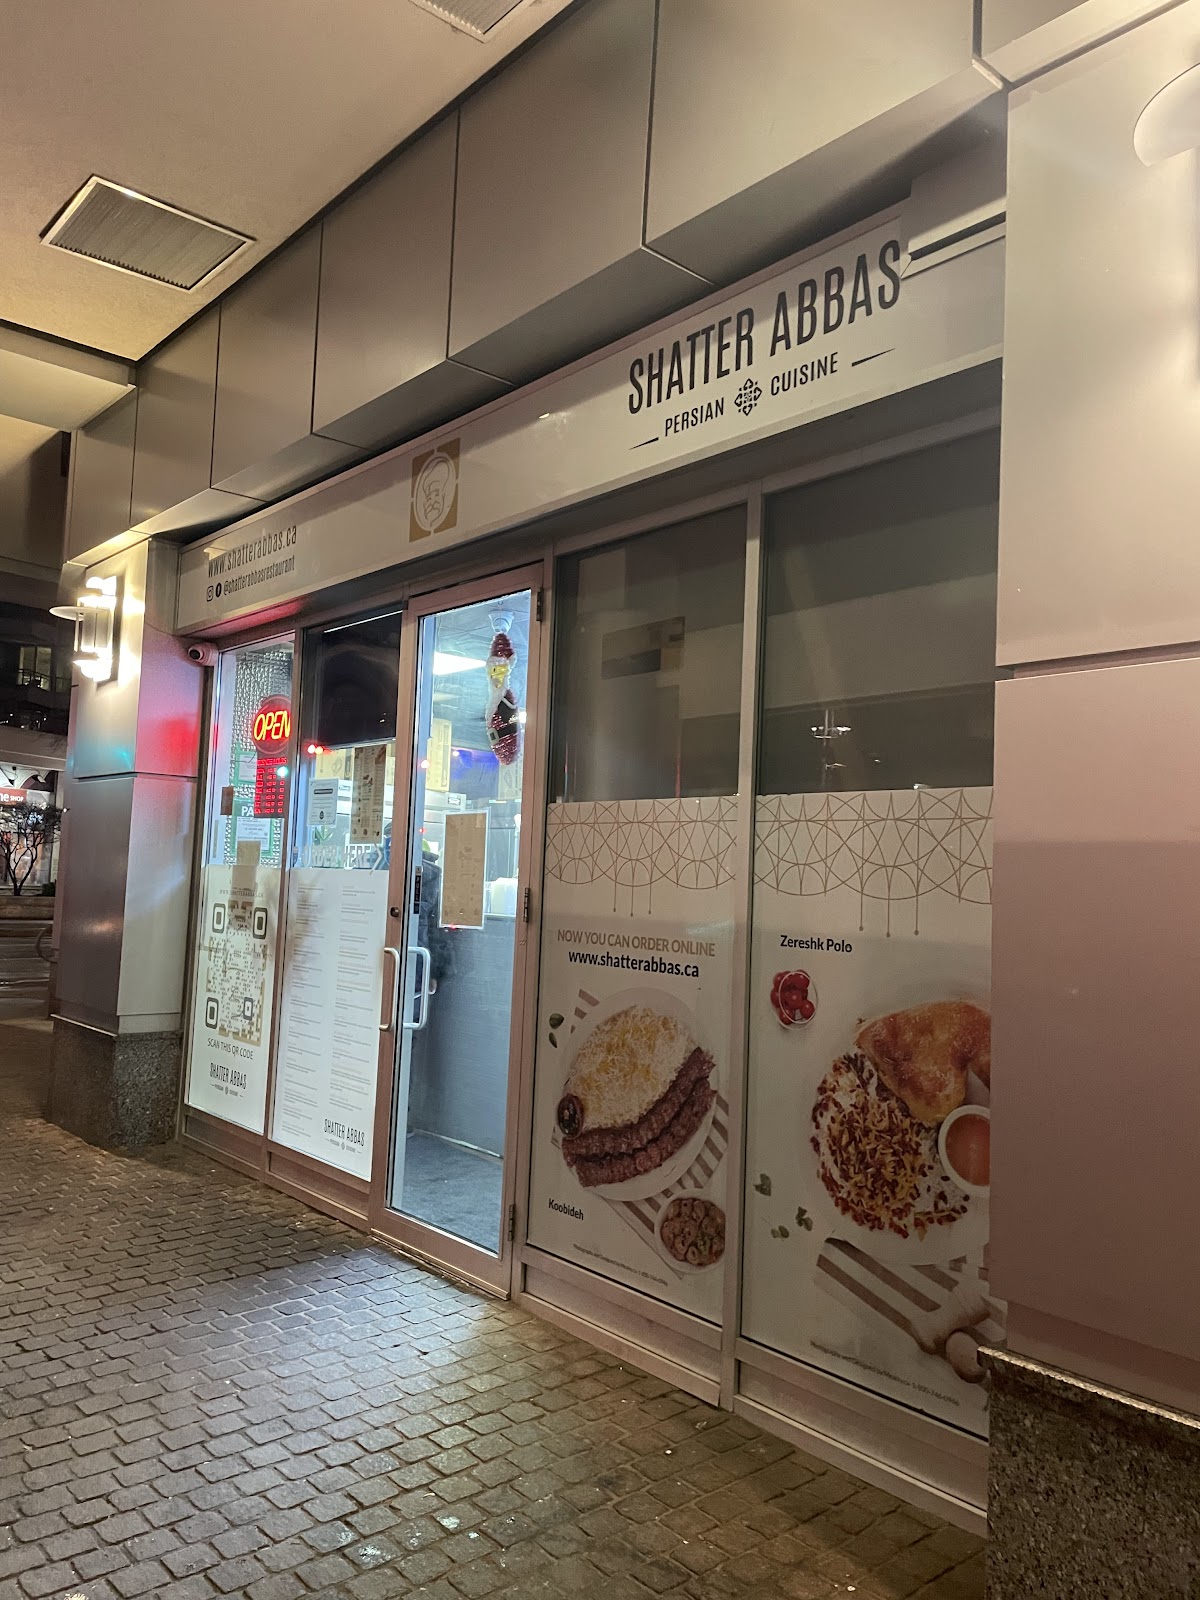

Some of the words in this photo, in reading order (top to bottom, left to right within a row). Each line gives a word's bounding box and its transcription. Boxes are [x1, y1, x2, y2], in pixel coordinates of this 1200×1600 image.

[628, 307, 754, 415] SHATTER
[770, 239, 900, 357] ABBAS
[665, 397, 725, 437] PERSIAN
[770, 352, 838, 396] CUISINE
[208, 525, 297, 578] www.shatterabbas.ca
[223, 555, 295, 595] @shatterabbasrestaurant
[253, 709, 291, 741] OPEN
[557, 929, 583, 944] NOW
[585, 931, 606, 945] YOU
[607, 934, 630, 948] CAN
[631, 936, 669, 952] ORDER
[671, 939, 716, 957] ONLINE
[780, 935, 824, 951] Zereshk
[826, 938, 853, 953] Polo
[568, 951, 699, 978] www.shatterabbas.ca
[207, 1037, 220, 1049] SCAN
[220, 1041, 231, 1053] THIS
[232, 1045, 239, 1057] QR
[240, 1048, 254, 1060] CODE
[209, 1062, 229, 1083] SHATTER
[229, 1069, 247, 1090] ABBAS
[324, 1118, 345, 1139] SHATTER
[346, 1126, 365, 1147] ABBAS
[548, 1198, 584, 1221] Koobideh
